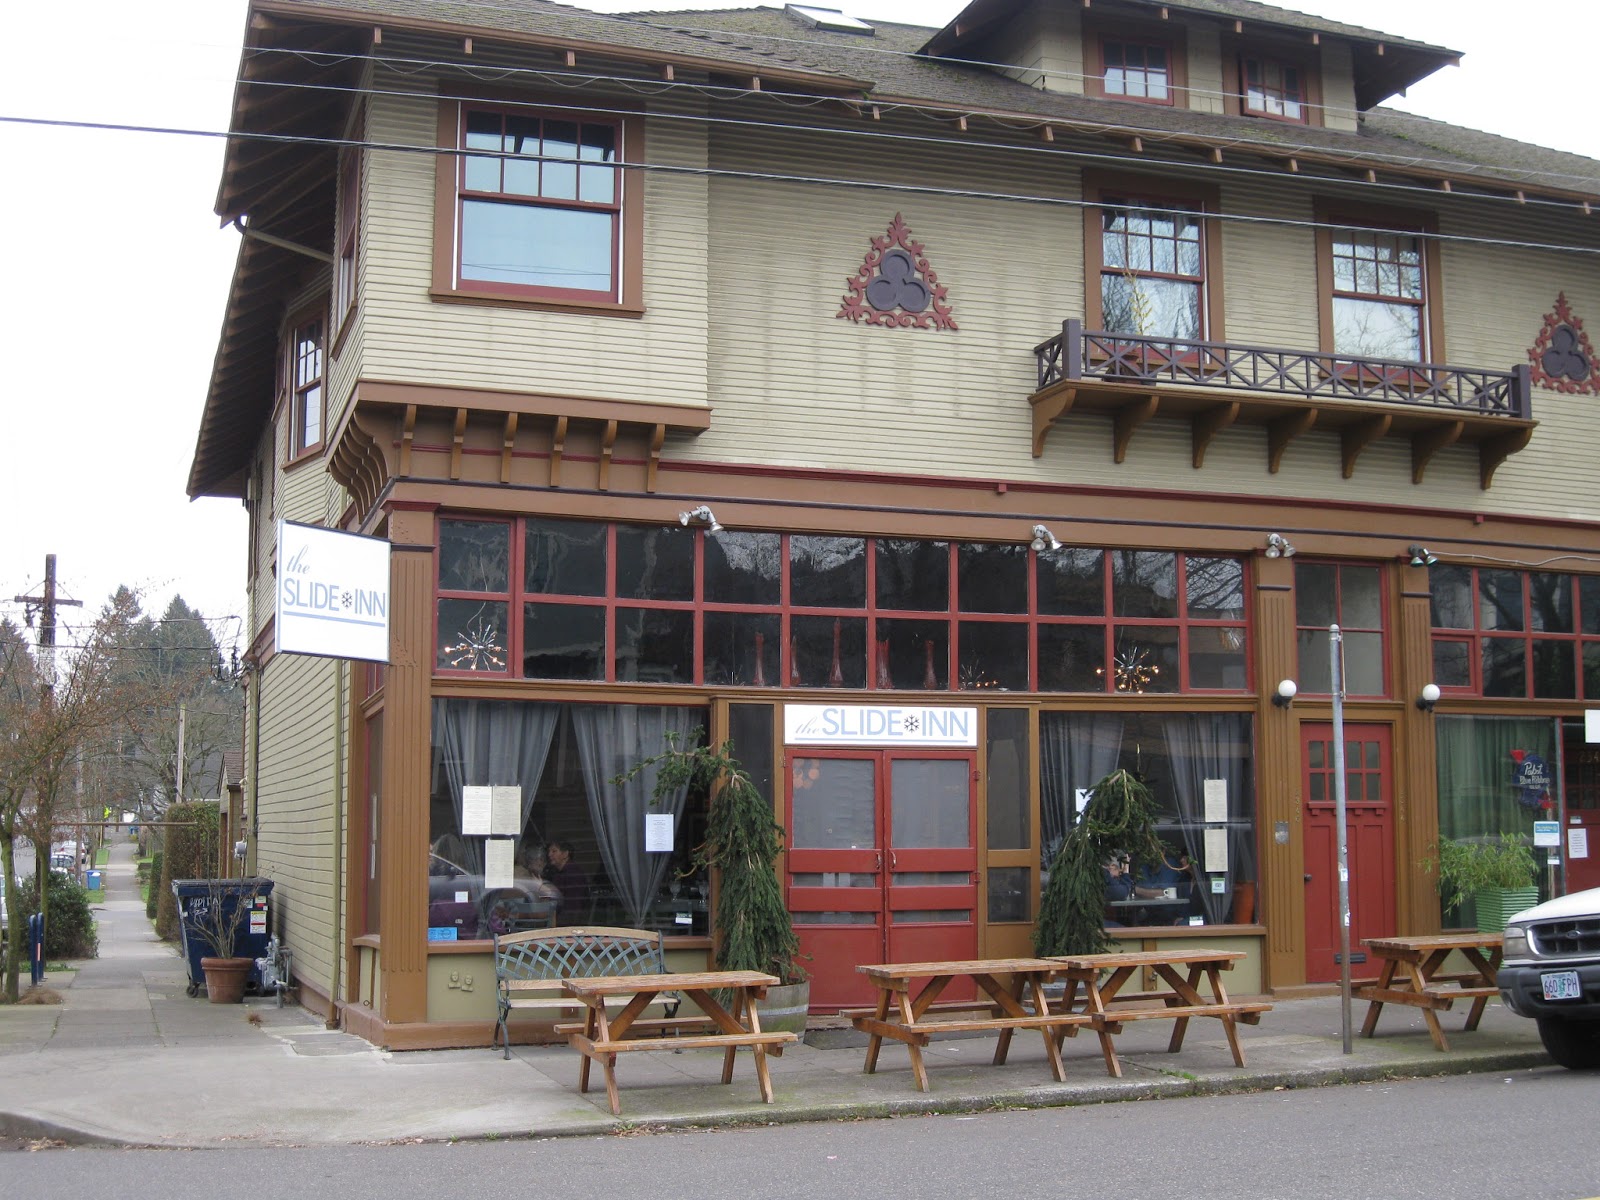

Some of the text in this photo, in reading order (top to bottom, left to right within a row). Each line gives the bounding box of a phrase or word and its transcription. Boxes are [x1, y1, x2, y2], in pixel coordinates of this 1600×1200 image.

[286, 544, 311, 575] the
[283, 577, 386, 618] SLIDE INN
[822, 708, 904, 736] SLIDE
[922, 710, 968, 737] INN
[1524, 761, 1543, 776] Pabst
[1544, 979, 1558, 994] 660
